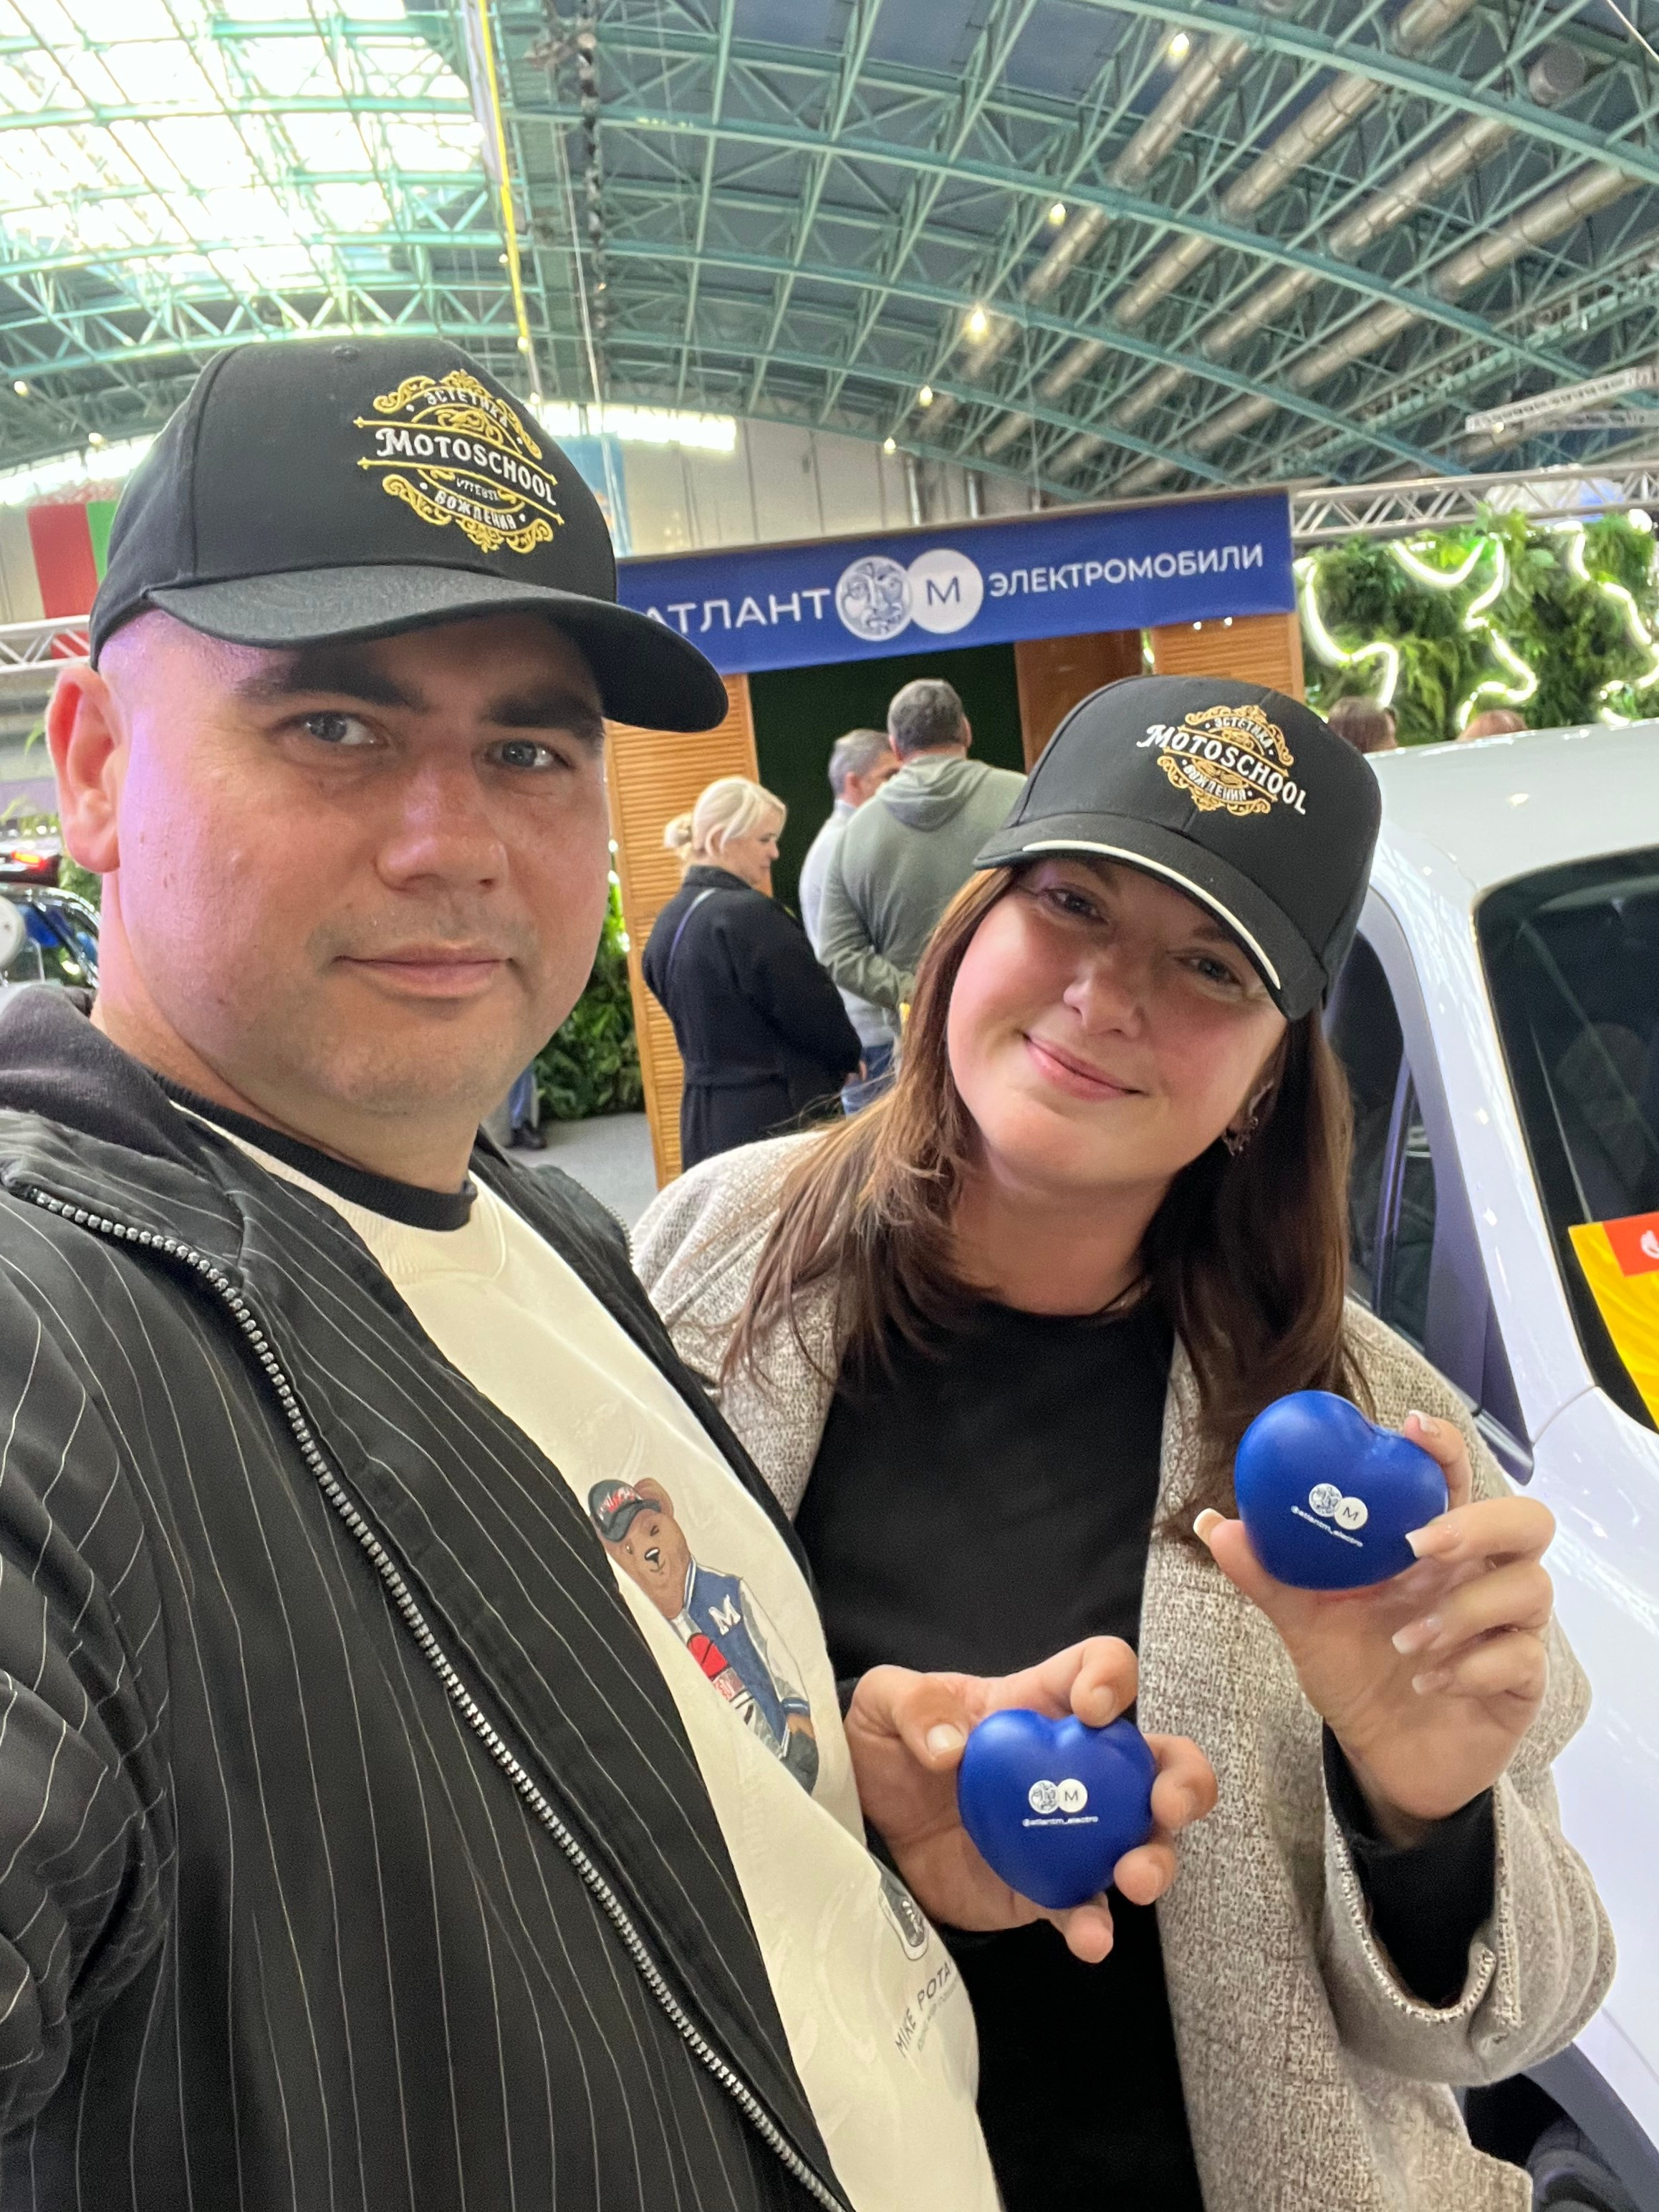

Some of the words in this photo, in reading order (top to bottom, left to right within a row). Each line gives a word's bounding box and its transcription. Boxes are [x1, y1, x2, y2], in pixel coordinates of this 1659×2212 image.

[375, 428, 557, 506] MOTOSCHOOL
[434, 490, 516, 530] ВОЖДЕНИЯ
[988, 542, 1264, 597] ЭЛЕКТРОМОБИЛИ
[1214, 716, 1274, 749] ЭСТЕТИКА
[1136, 723, 1307, 815] MOTOSCHOOL
[1183, 764, 1246, 802] ВОЖДЕНИЯ
[708, 1593, 741, 1636] M
[895, 2007, 916, 2059] MIKE
[917, 1959, 953, 2012] POTA
